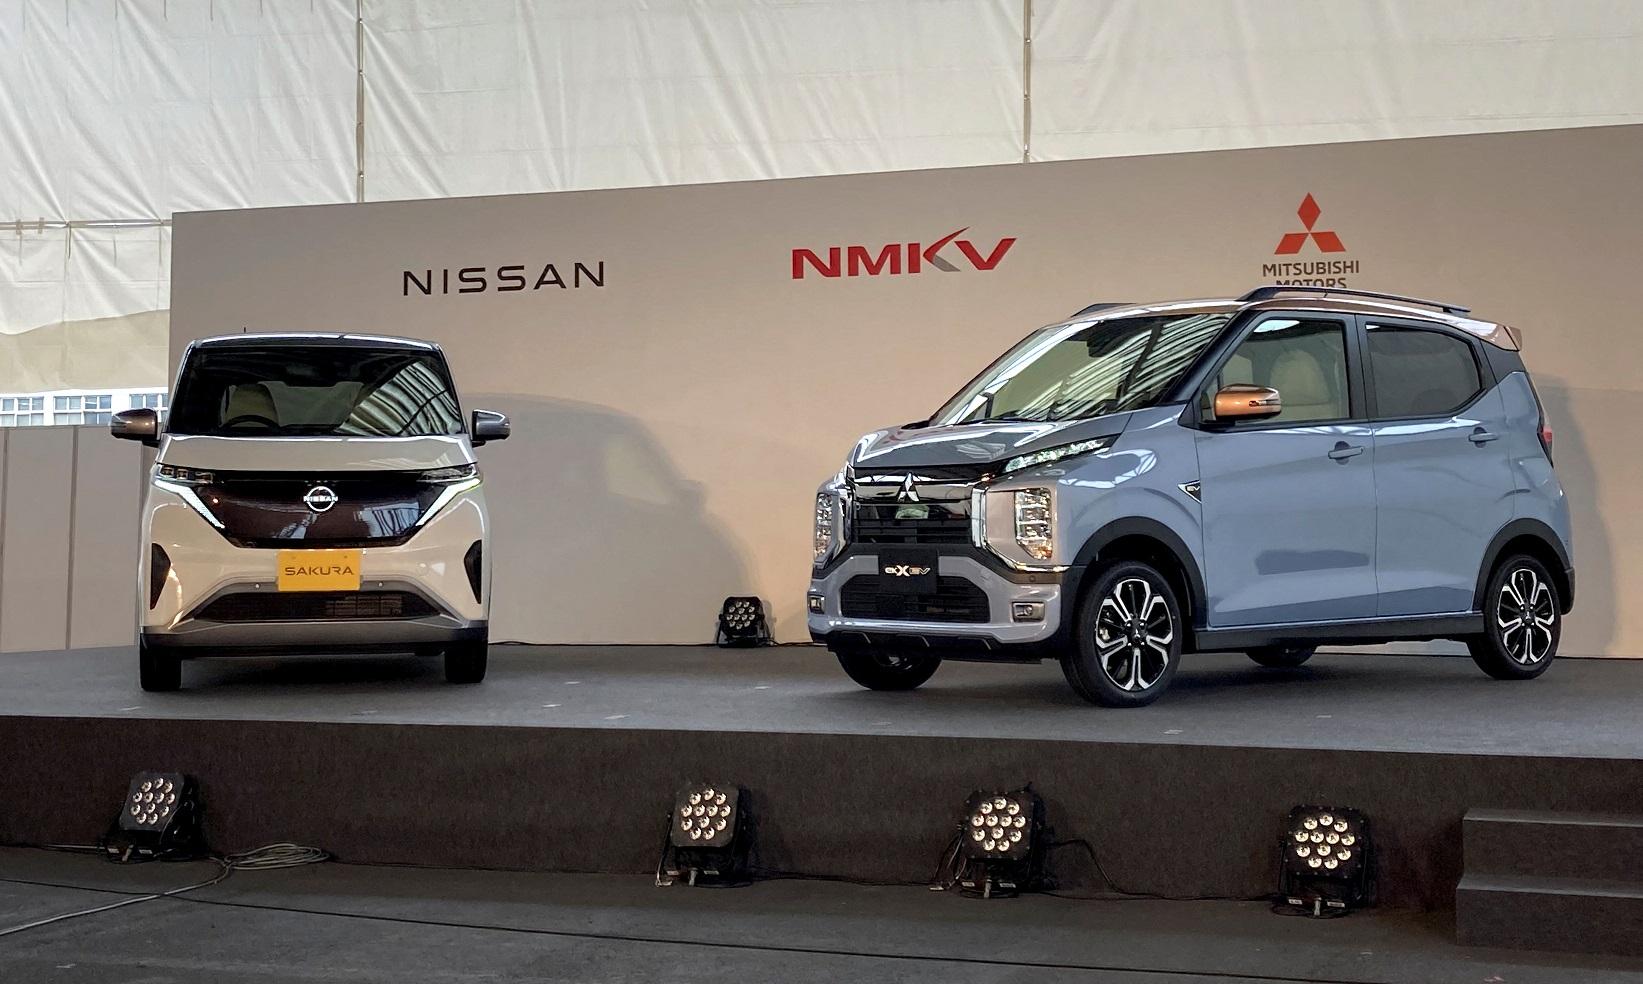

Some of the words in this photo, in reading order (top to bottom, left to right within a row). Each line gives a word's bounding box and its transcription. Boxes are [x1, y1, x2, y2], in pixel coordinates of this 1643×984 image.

[792, 226, 1017, 280] NMKV
[403, 261, 604, 296] NISSAN
[1262, 260, 1360, 277] MITSUBISHI
[284, 566, 354, 576] SAKURA
